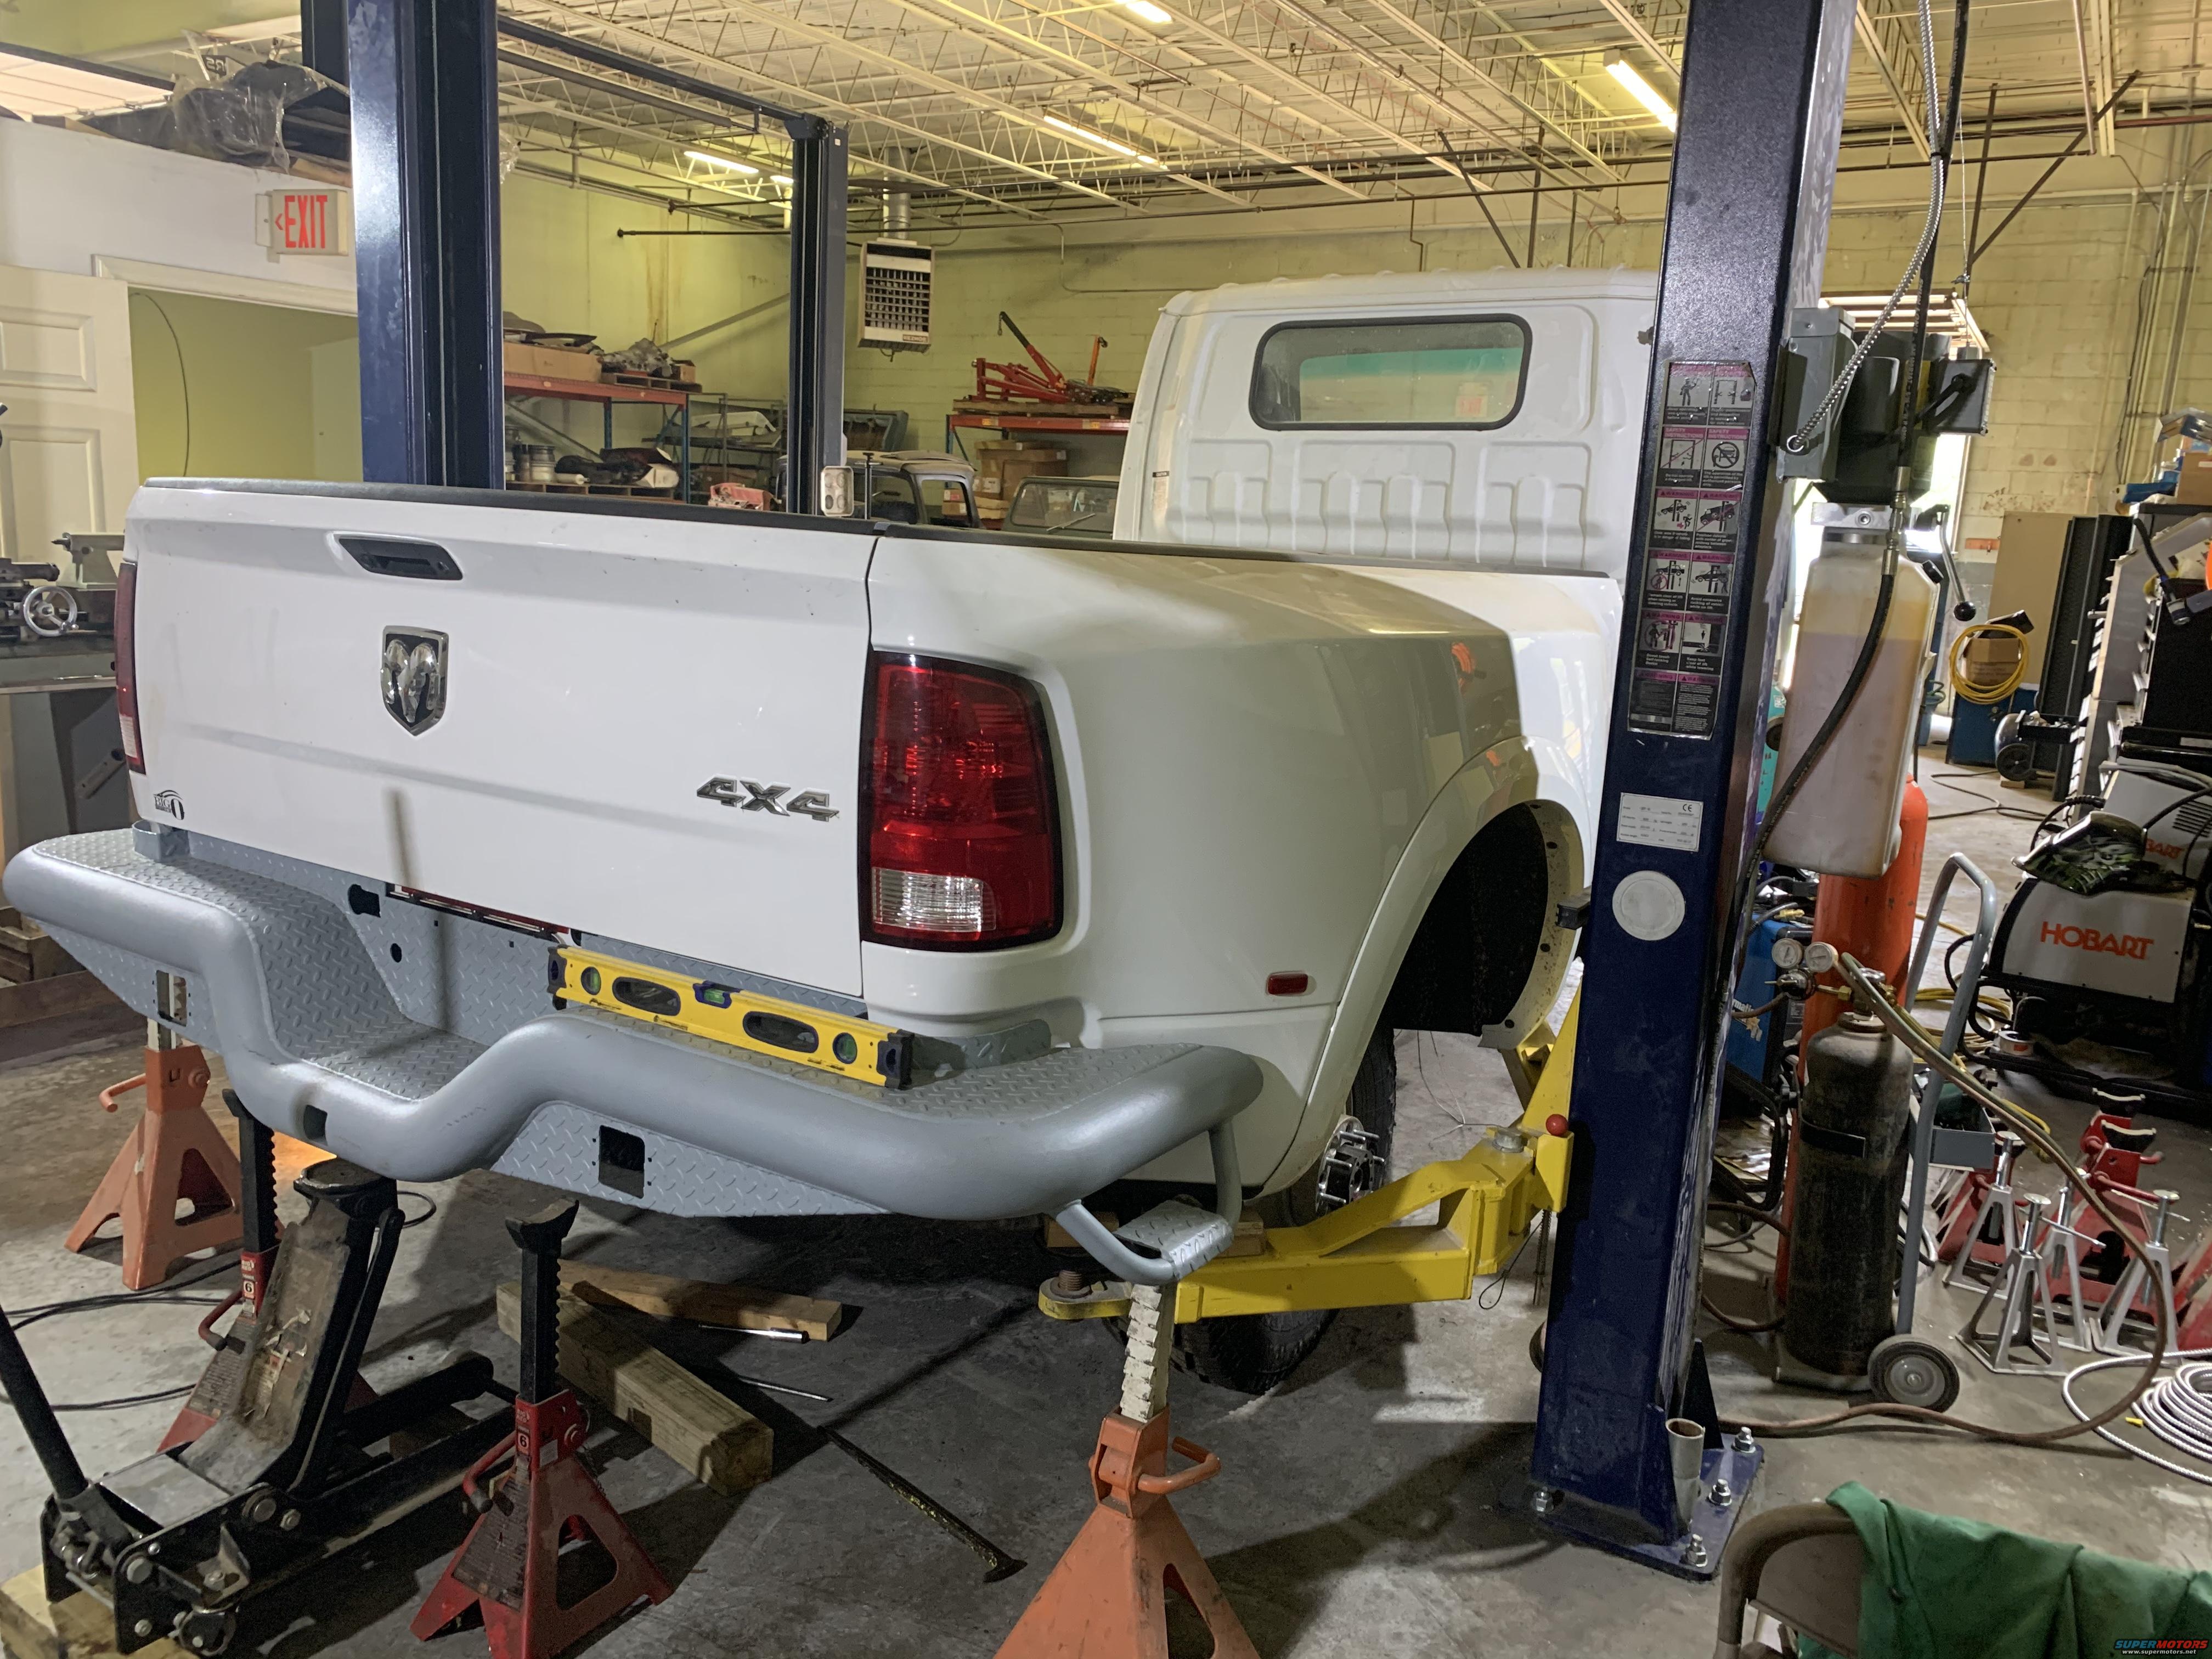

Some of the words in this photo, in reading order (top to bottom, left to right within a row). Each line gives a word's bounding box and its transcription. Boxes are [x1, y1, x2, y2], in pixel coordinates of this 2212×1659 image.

[284, 195, 328, 249] EXIT
[2146, 838, 2186, 860] BART
[2040, 921, 2154, 960] HOBART
[245, 1283, 252, 1293] 6
[520, 1435, 527, 1447] 6
